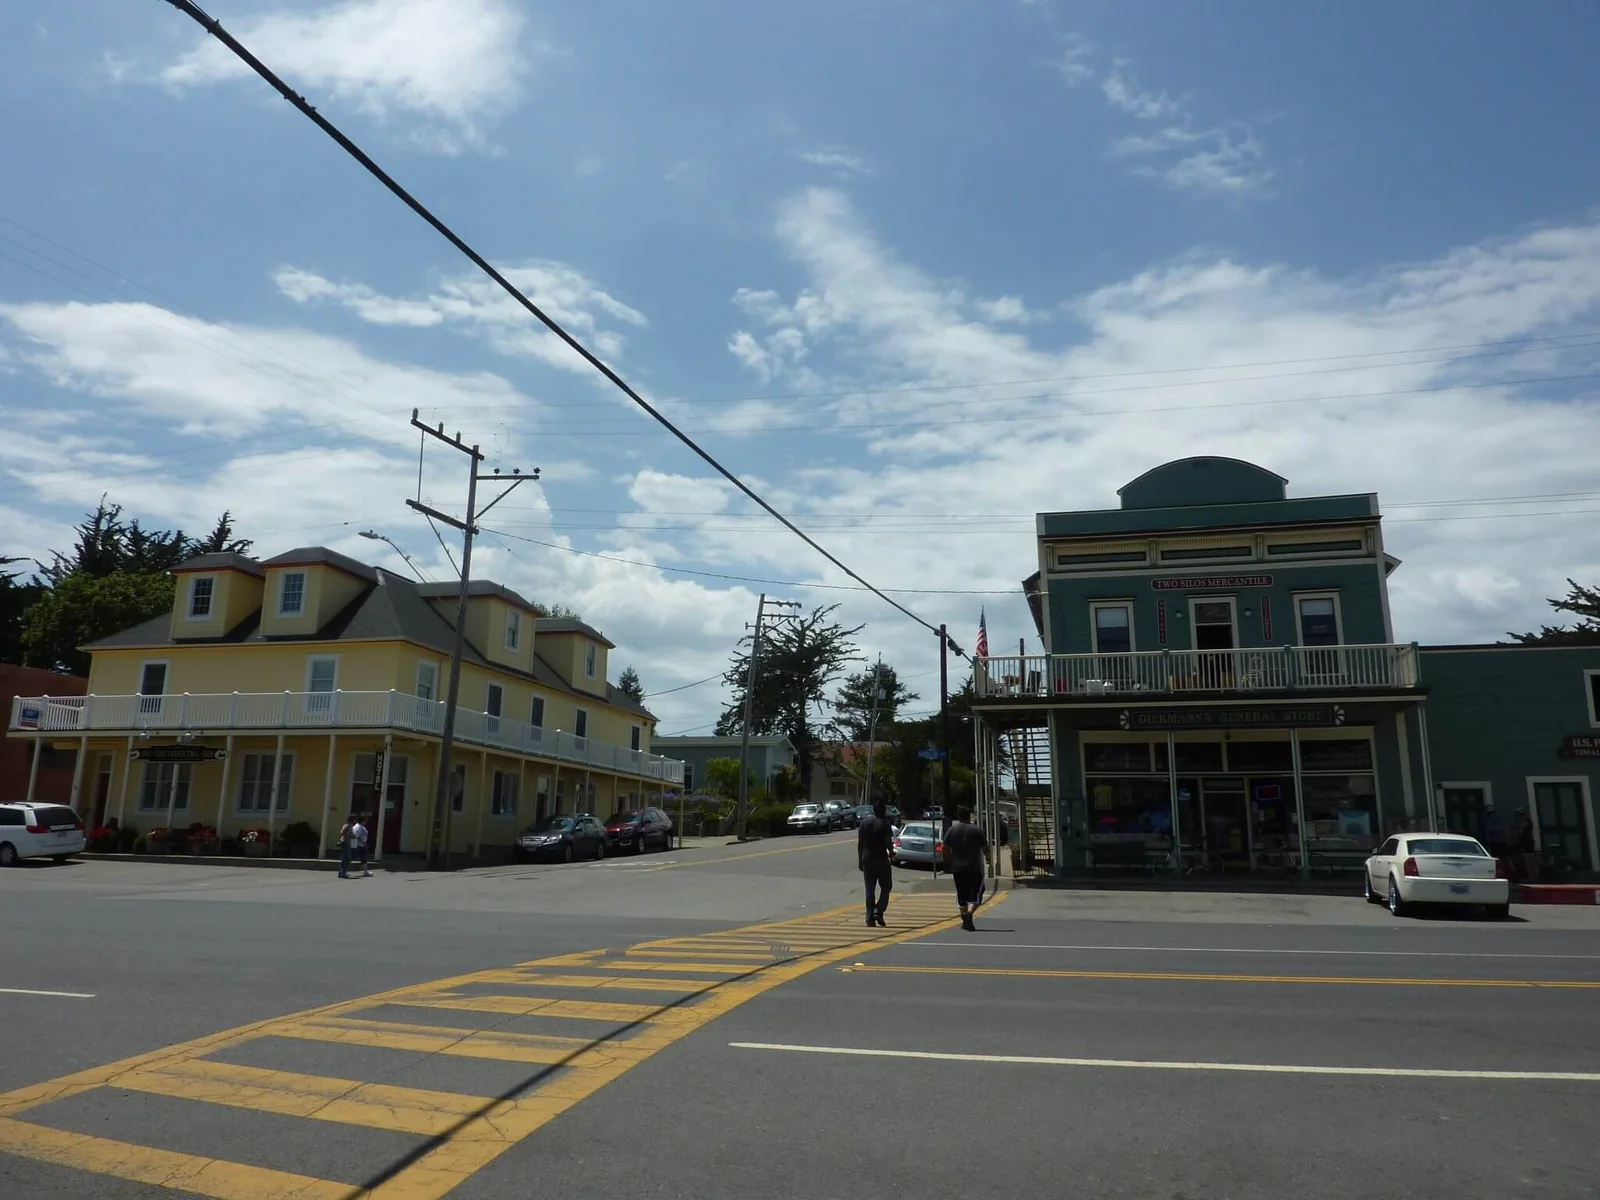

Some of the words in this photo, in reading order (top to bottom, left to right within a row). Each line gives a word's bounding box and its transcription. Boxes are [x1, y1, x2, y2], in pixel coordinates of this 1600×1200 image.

[1156, 579, 1178, 589] TWO
[1180, 578, 1206, 588] SILOS
[1207, 576, 1269, 587] MERCANTILE
[1219, 710, 1276, 722] GENERAL
[1283, 710, 1324, 721] STORE
[374, 754, 383, 790] HOTEL
